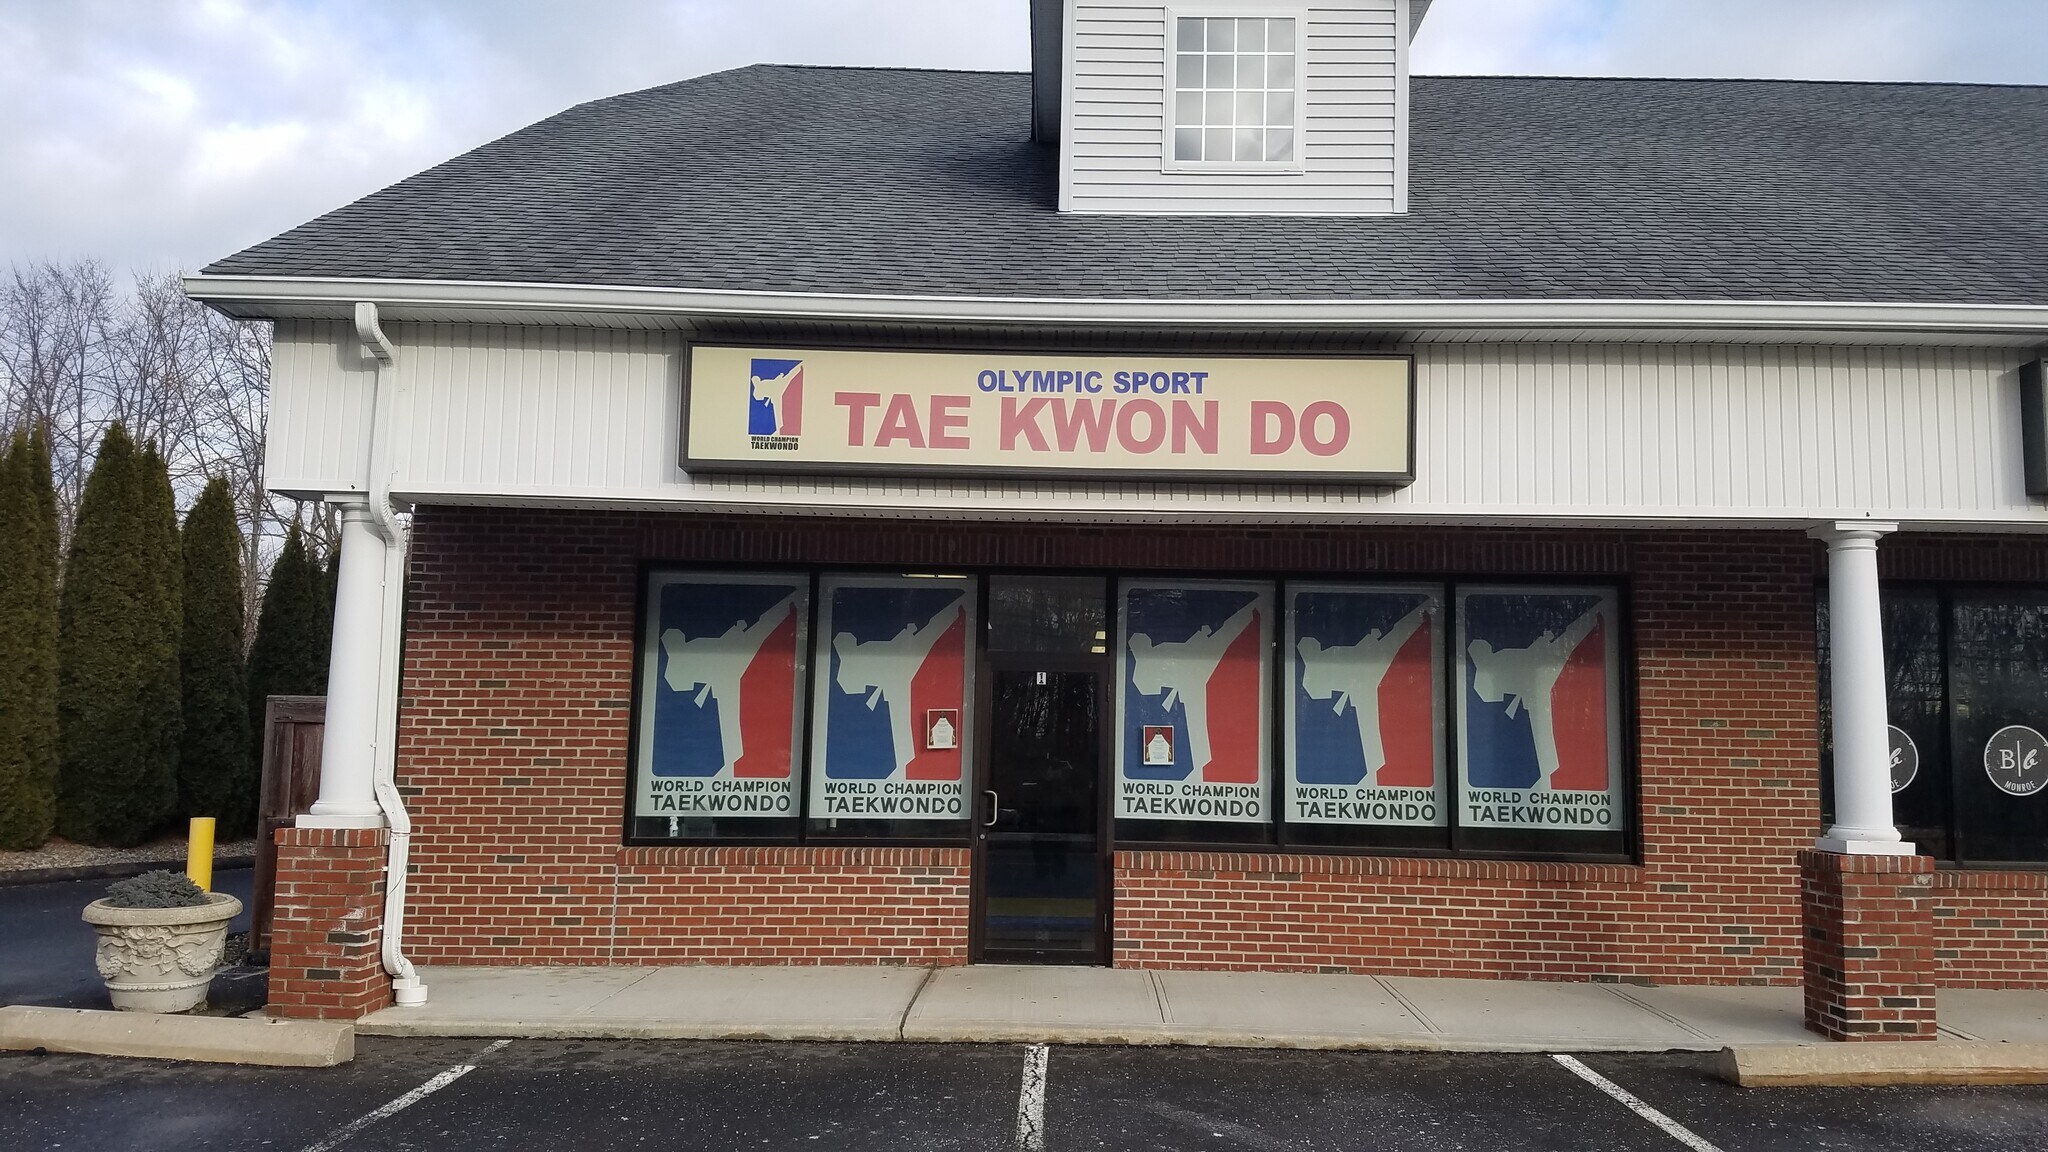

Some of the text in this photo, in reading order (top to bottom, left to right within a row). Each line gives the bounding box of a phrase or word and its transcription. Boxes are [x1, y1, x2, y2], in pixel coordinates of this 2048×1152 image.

[977, 369, 1209, 394] OLYMPIC SPORT
[834, 391, 1351, 456] TAE KWON DO
[751, 442, 799, 450] TAEKWONDO
[651, 780, 791, 793] WORLD CHAMPION
[825, 782, 962, 795] WORLD CHAMPION
[1123, 783, 1260, 798] WORLD CHAMPION
[2004, 780, 2037, 792] MONROE
[1296, 787, 1435, 802] WORLD CHAMPION
[1468, 791, 1611, 806] WORLD CHAMPION
[650, 794, 791, 812] TAEKWONDO
[824, 796, 962, 814] TAEKWONDO
[1123, 797, 1260, 817] TAEKWONDO
[1296, 801, 1436, 821] TAEKWONDO
[1469, 805, 1611, 825] TAEKWONDO
